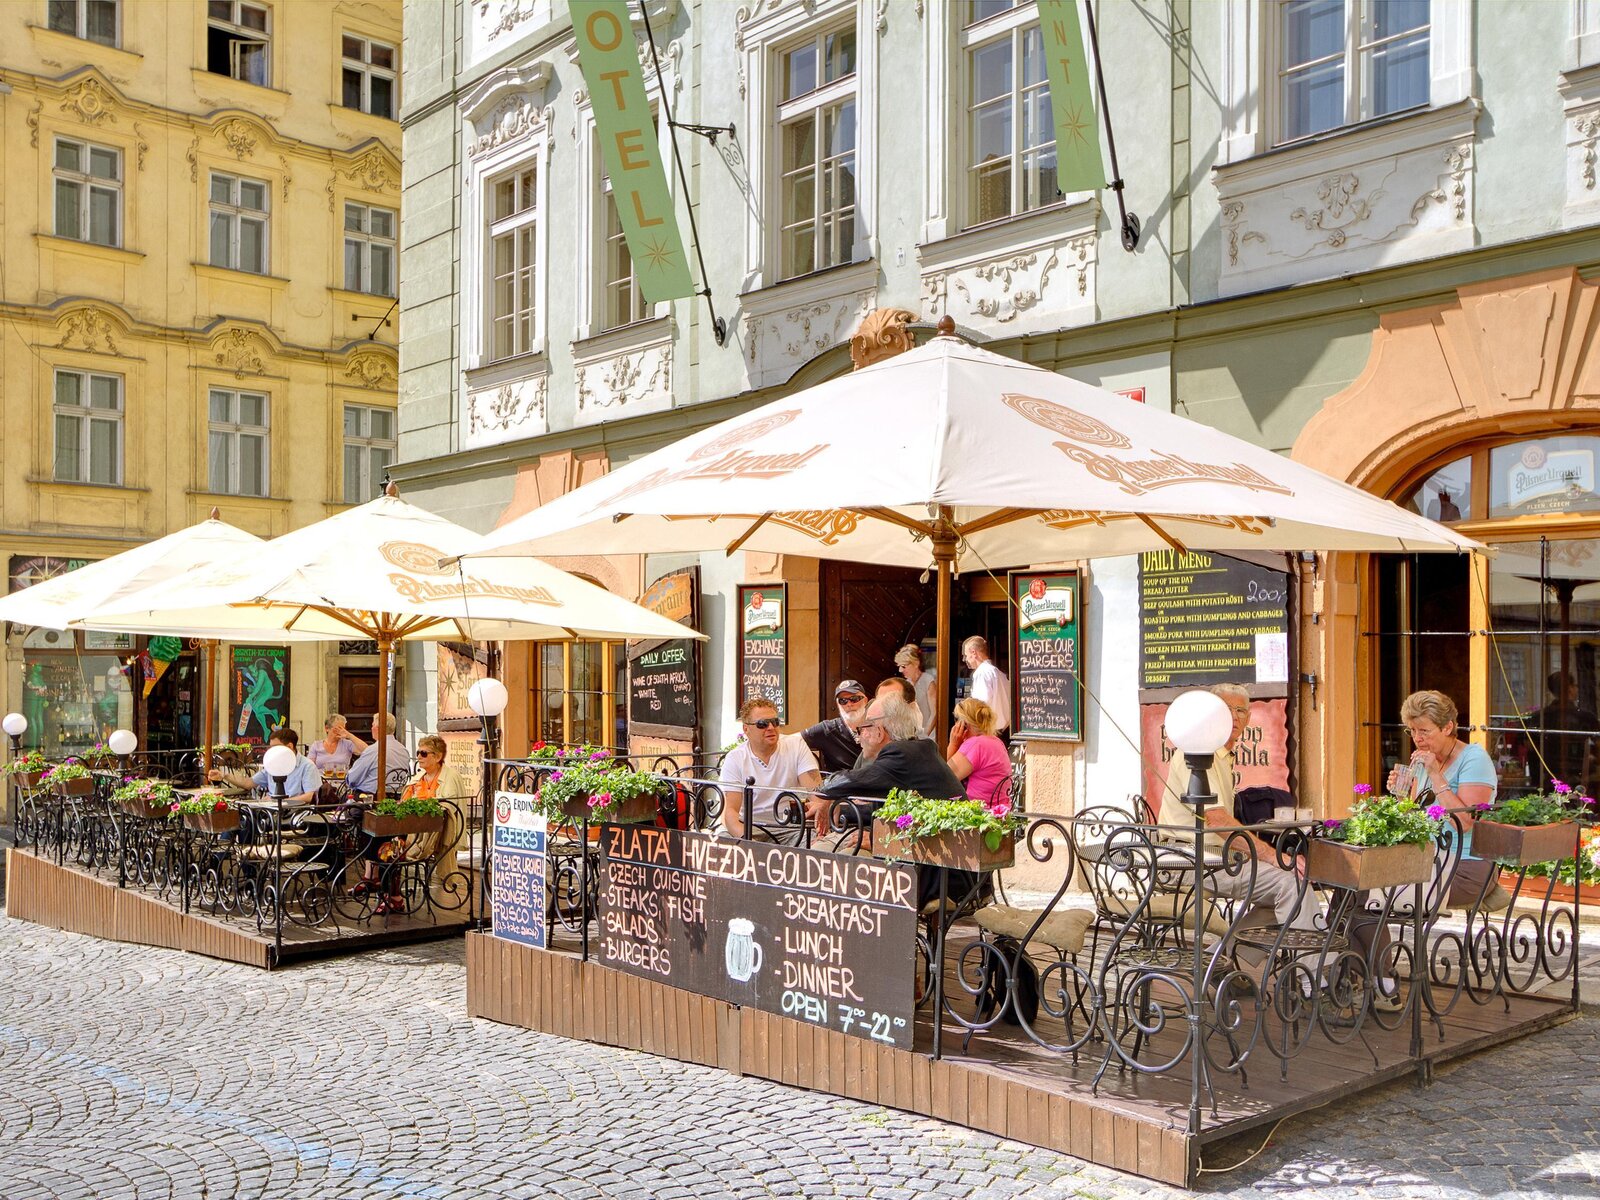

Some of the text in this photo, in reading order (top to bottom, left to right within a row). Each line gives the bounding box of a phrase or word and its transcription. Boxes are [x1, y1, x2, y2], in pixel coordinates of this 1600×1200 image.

[1515, 465, 1582, 494] Pilsner Urquell
[1143, 549, 1212, 572] DAILY MENU
[1143, 575, 1194, 586] SOUP OF THE DAY
[387, 573, 559, 605] Pilsner Urquell
[1143, 586, 1189, 596] BREAD, BUTTER
[1025, 598, 1066, 618] Pilsner Urquell
[1144, 601, 1158, 610] BEEF
[1158, 600, 1185, 609] GOULASH
[1185, 598, 1201, 608] WITH
[1201, 597, 1225, 606] POTATO
[1144, 609, 1283, 625] ROASTED PORK WITH DUMPLINGS AND CABBAGES
[1144, 625, 1281, 641] SMOKED PORK WITH DUMPLINGS AND CABBAGES
[744, 639, 784, 655] EXCHANGE
[1020, 638, 1075, 655] TASTE OUR
[1144, 642, 1250, 654] CHICKEN STEAK WITH FRENCH FRIES
[640, 648, 686, 664] DAILY OFFER
[1020, 653, 1074, 669] BURGERS
[1145, 657, 1257, 669] FRIED FISH STEAK WITH FRENCH FRIES
[749, 658, 767, 674] 0%
[632, 676, 646, 687] WINE
[646, 674, 653, 686] OF
[653, 673, 669, 684] SOUTH
[743, 674, 780, 687] COMMISSION
[1145, 674, 1171, 683] DESSERT
[650, 700, 661, 711] RED
[496, 826, 539, 850] BEERS
[494, 852, 522, 874] PILSNER
[608, 827, 670, 864] ZLATÁ
[855, 863, 917, 912] STAR
[495, 870, 529, 892] MASTER
[653, 870, 707, 900] CUISINE
[494, 885, 532, 908] ERDINGER
[494, 901, 530, 925] FRISCO
[781, 990, 828, 1023] OPEN
